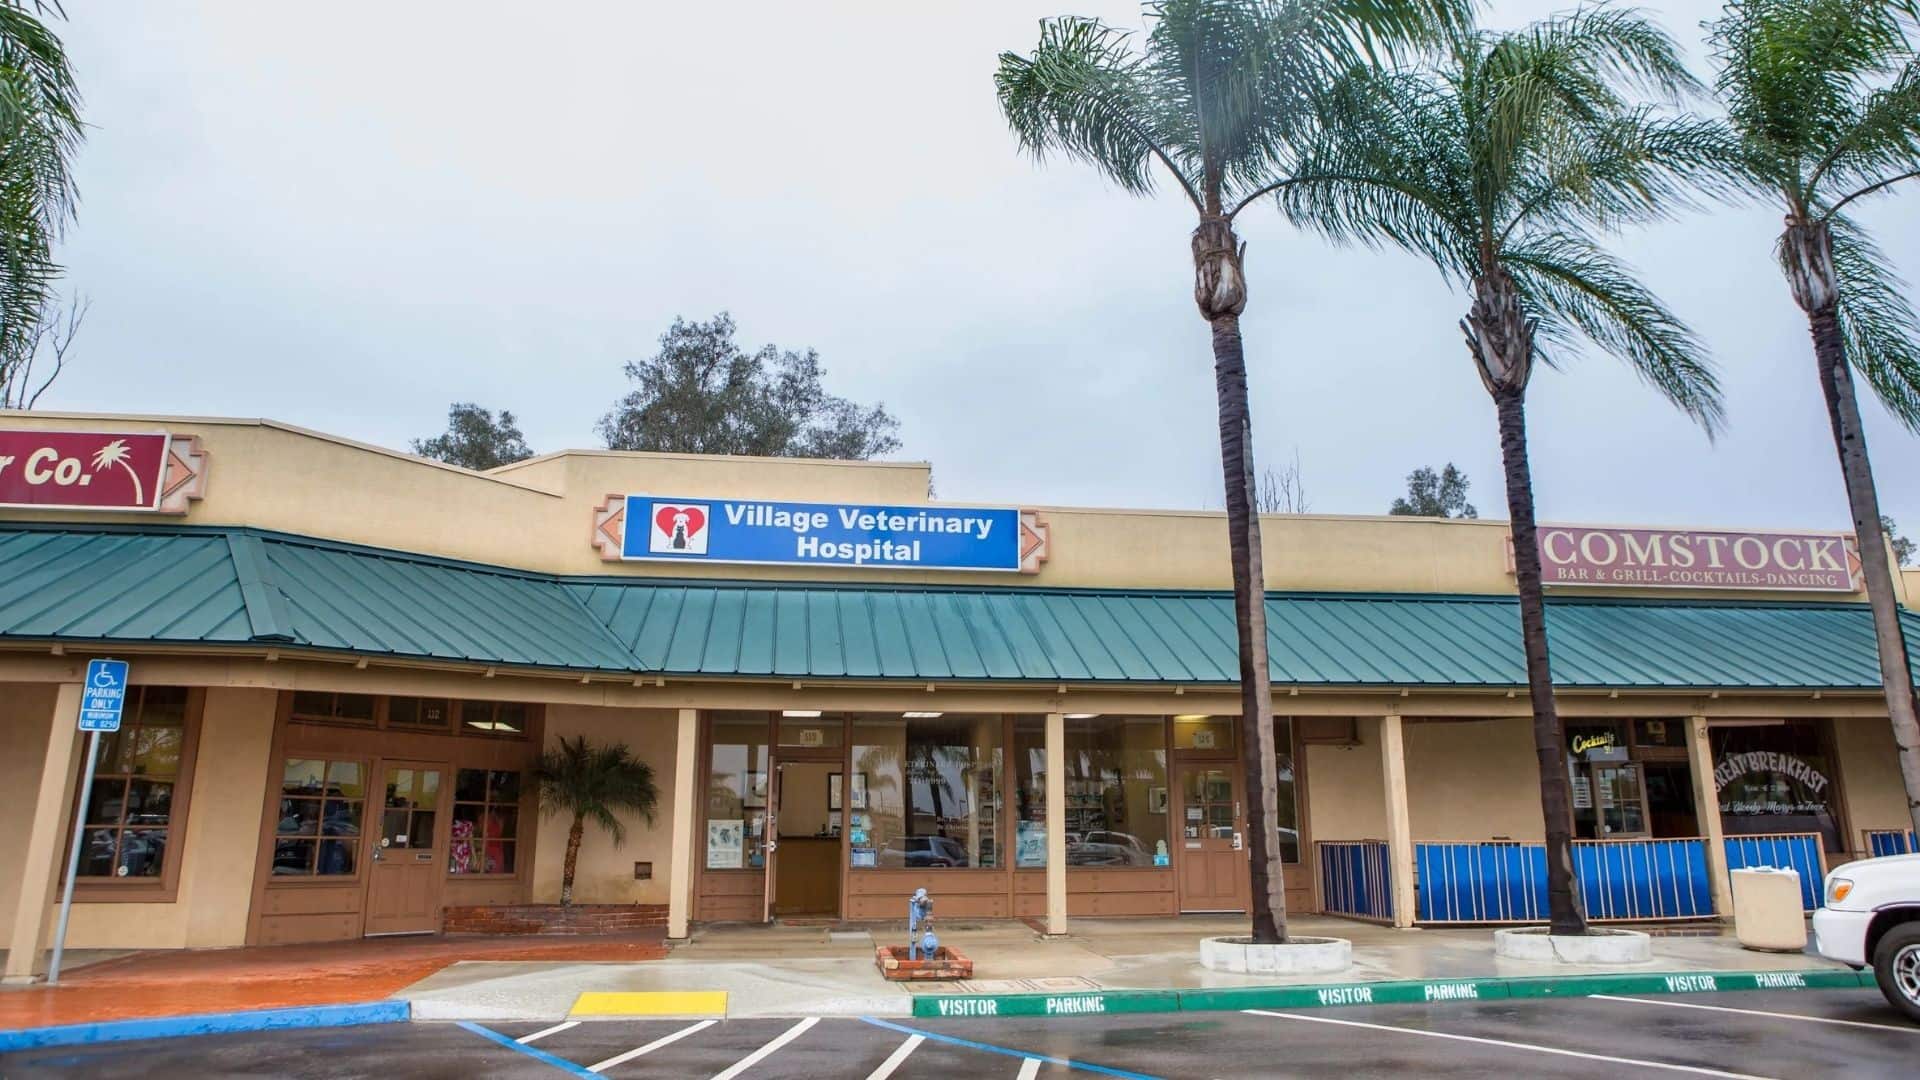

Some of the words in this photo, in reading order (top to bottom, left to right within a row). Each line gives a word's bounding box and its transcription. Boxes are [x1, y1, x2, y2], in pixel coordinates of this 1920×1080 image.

[24, 447, 92, 486] Co.
[724, 504, 830, 533] Village
[838, 508, 994, 540] Veterinary
[796, 536, 921, 564] Hospital
[1543, 530, 1846, 572] COMSTOCK
[1557, 567, 1589, 580] BAR
[1595, 569, 1606, 580] &
[87, 687, 122, 698] PARKING
[90, 698, 114, 709] ONLY
[1572, 731, 1615, 754] Cocktails
[1747, 751, 1828, 793] BREAKFAST
[1665, 975, 1717, 992] VISITOR
[1754, 973, 1806, 988] PARKING
[1318, 987, 1373, 1005] VISITOR
[1424, 983, 1478, 1001] PARKING
[938, 999, 997, 1016] VISITOR
[1046, 996, 1105, 1014] PARKING
